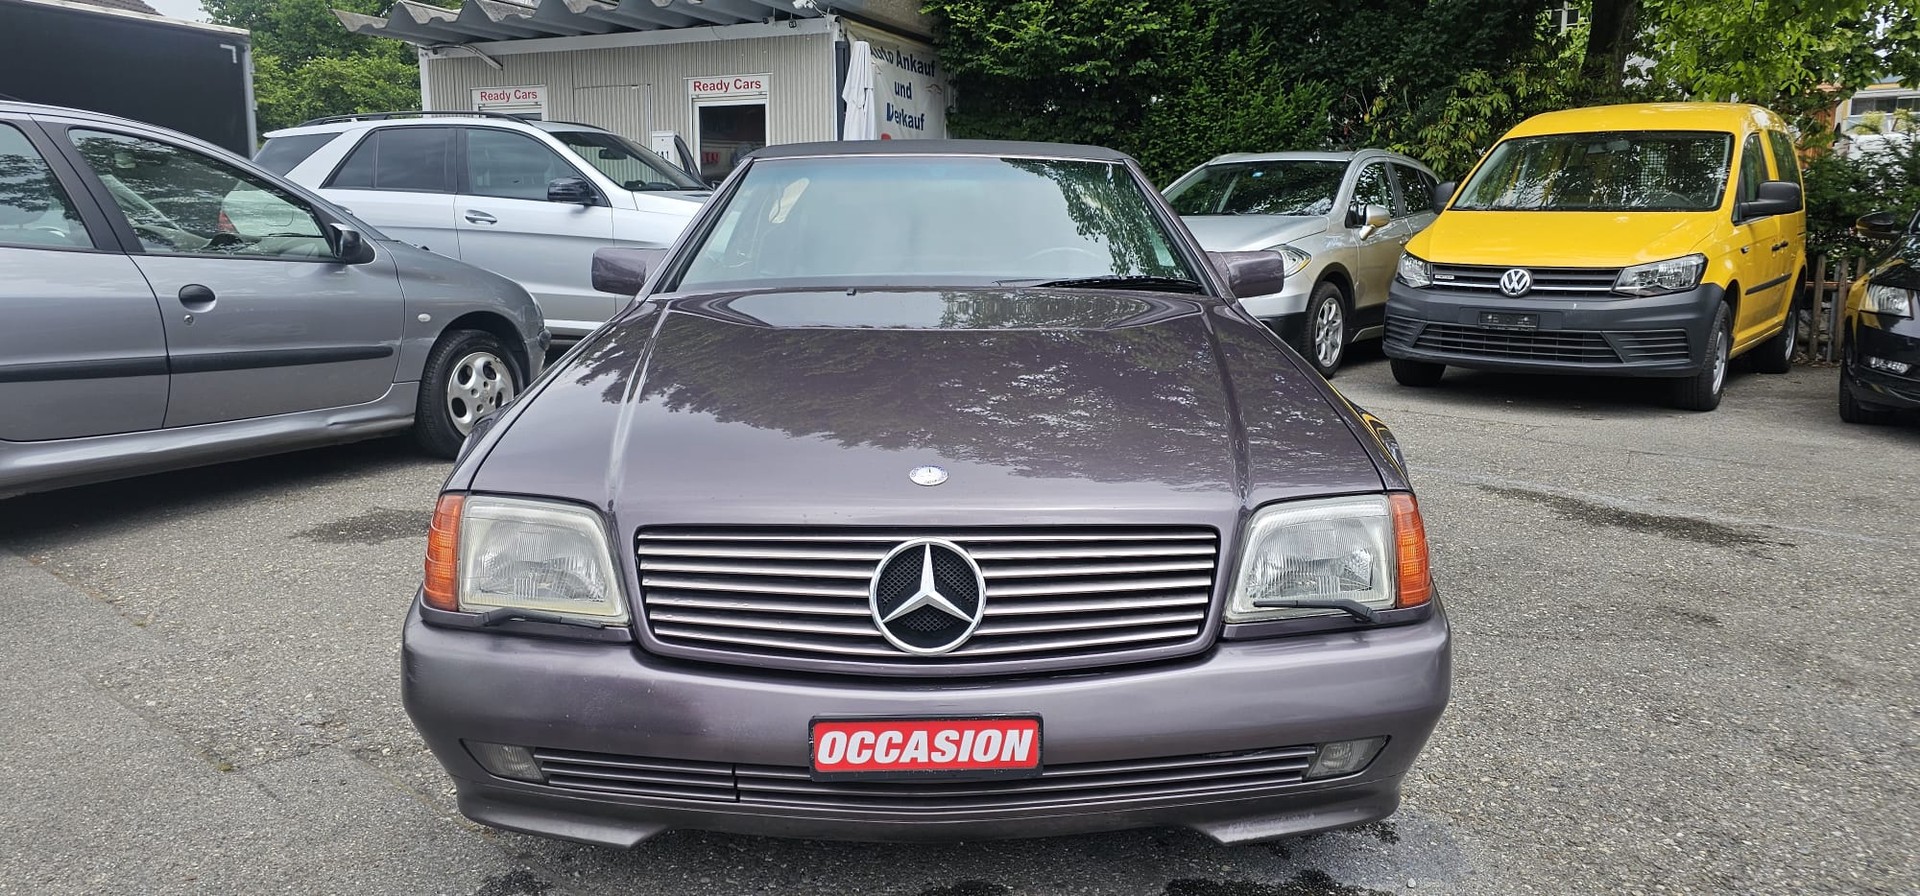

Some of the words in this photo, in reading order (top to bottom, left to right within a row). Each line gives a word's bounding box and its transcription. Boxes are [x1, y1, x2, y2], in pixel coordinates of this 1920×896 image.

[870, 45, 894, 64] Auto
[896, 50, 936, 77] Ankauf
[693, 79, 730, 92] Ready
[733, 78, 762, 90] Cars
[894, 80, 912, 100] und
[480, 90, 511, 103] Ready
[514, 89, 538, 100] Cars
[817, 728, 1034, 765] OCCASION
